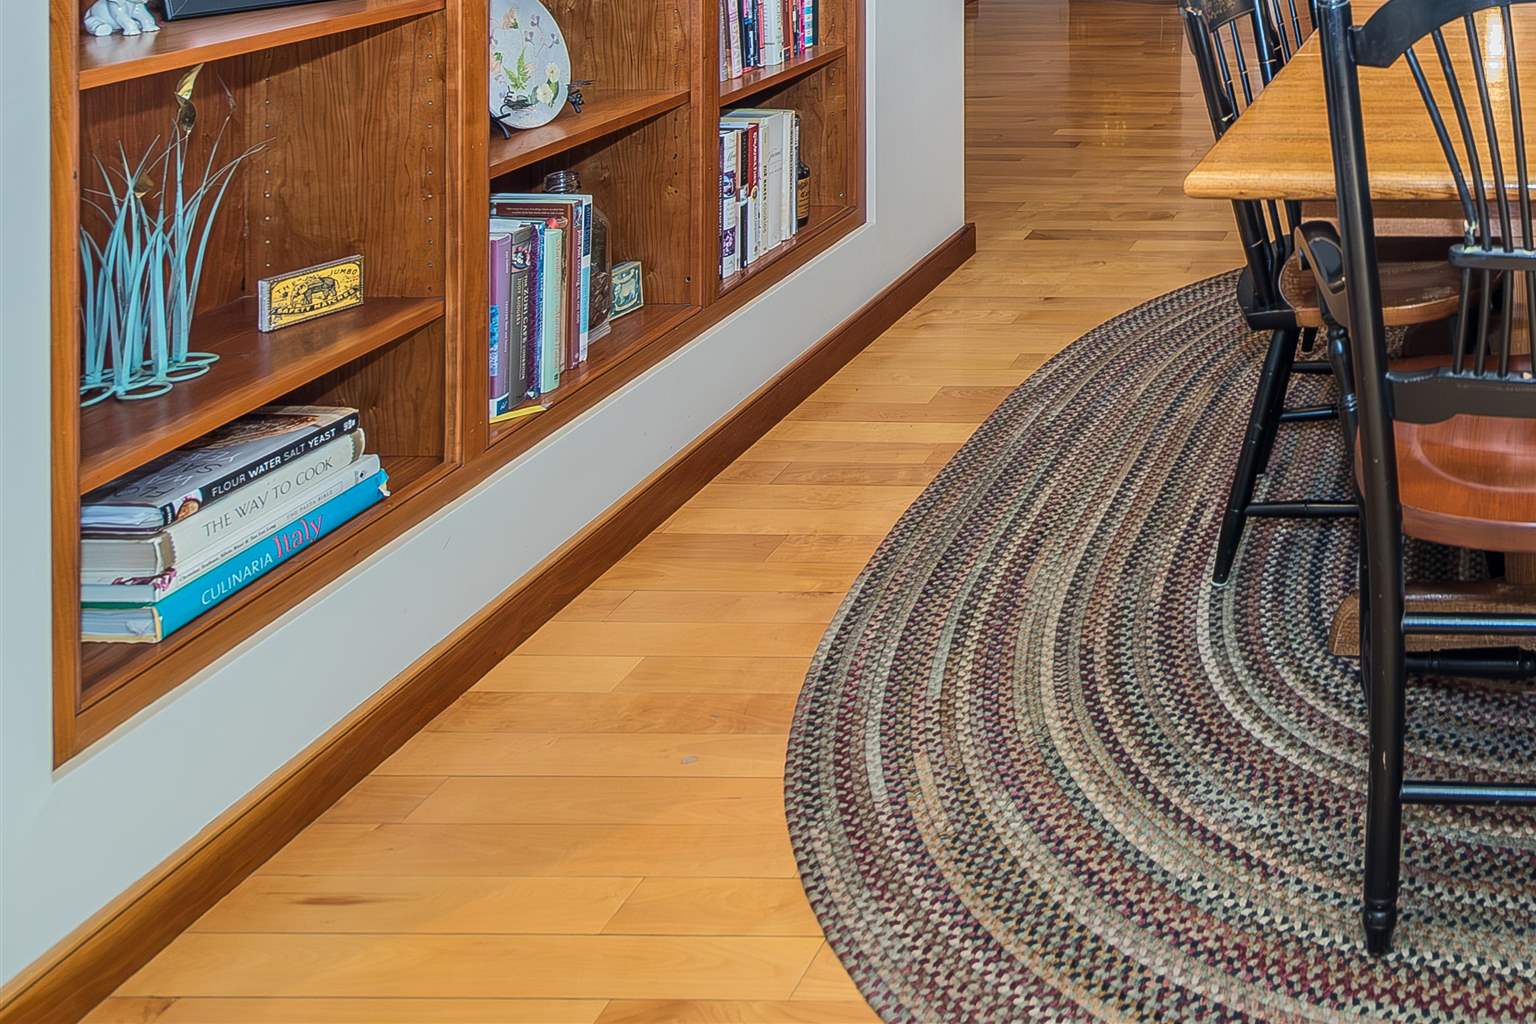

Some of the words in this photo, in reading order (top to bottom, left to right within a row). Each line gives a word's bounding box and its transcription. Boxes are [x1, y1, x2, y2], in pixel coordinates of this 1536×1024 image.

[328, 268, 358, 277] JUMBO
[203, 513, 232, 537] THE
[234, 490, 270, 519] WAY
[271, 479, 293, 500] TO
[295, 455, 335, 487] COOK
[211, 473, 247, 498] FLOUR
[247, 455, 282, 479] WATER
[283, 442, 306, 461] SALT
[307, 427, 336, 450] YEAST
[201, 552, 274, 606] CULINARIA
[273, 514, 324, 559] Italy
